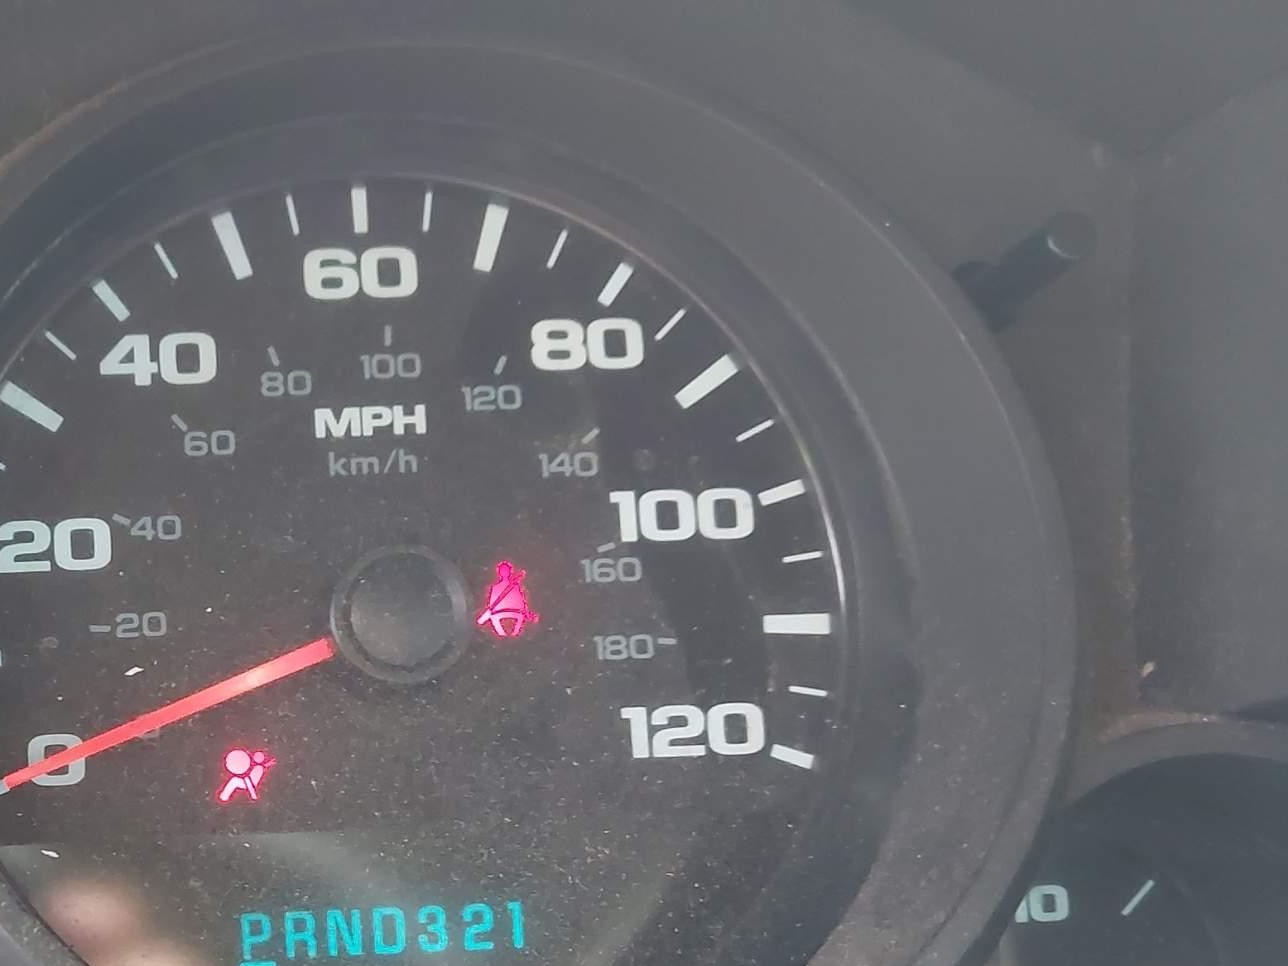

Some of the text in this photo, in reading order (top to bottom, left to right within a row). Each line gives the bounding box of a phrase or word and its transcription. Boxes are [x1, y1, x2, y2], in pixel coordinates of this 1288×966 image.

[303, 246, 419, 300] 60
[99, 331, 217, 387] 40
[530, 318, 644, 371] 80
[360, 351, 422, 380] 100
[260, 369, 313, 398] 80
[462, 382, 522, 412] 120
[313, 404, 427, 439] MPH
[183, 428, 237, 457] 60
[327, 448, 419, 476] km/h
[539, 450, 600, 478] 140
[129, 514, 183, 542] 40
[609, 487, 755, 542] 100
[580, 555, 643, 584] 160
[115, 611, 169, 639] 20
[593, 633, 654, 662] 180
[620, 703, 765, 758] 120
[27, 733, 86, 787] 0
